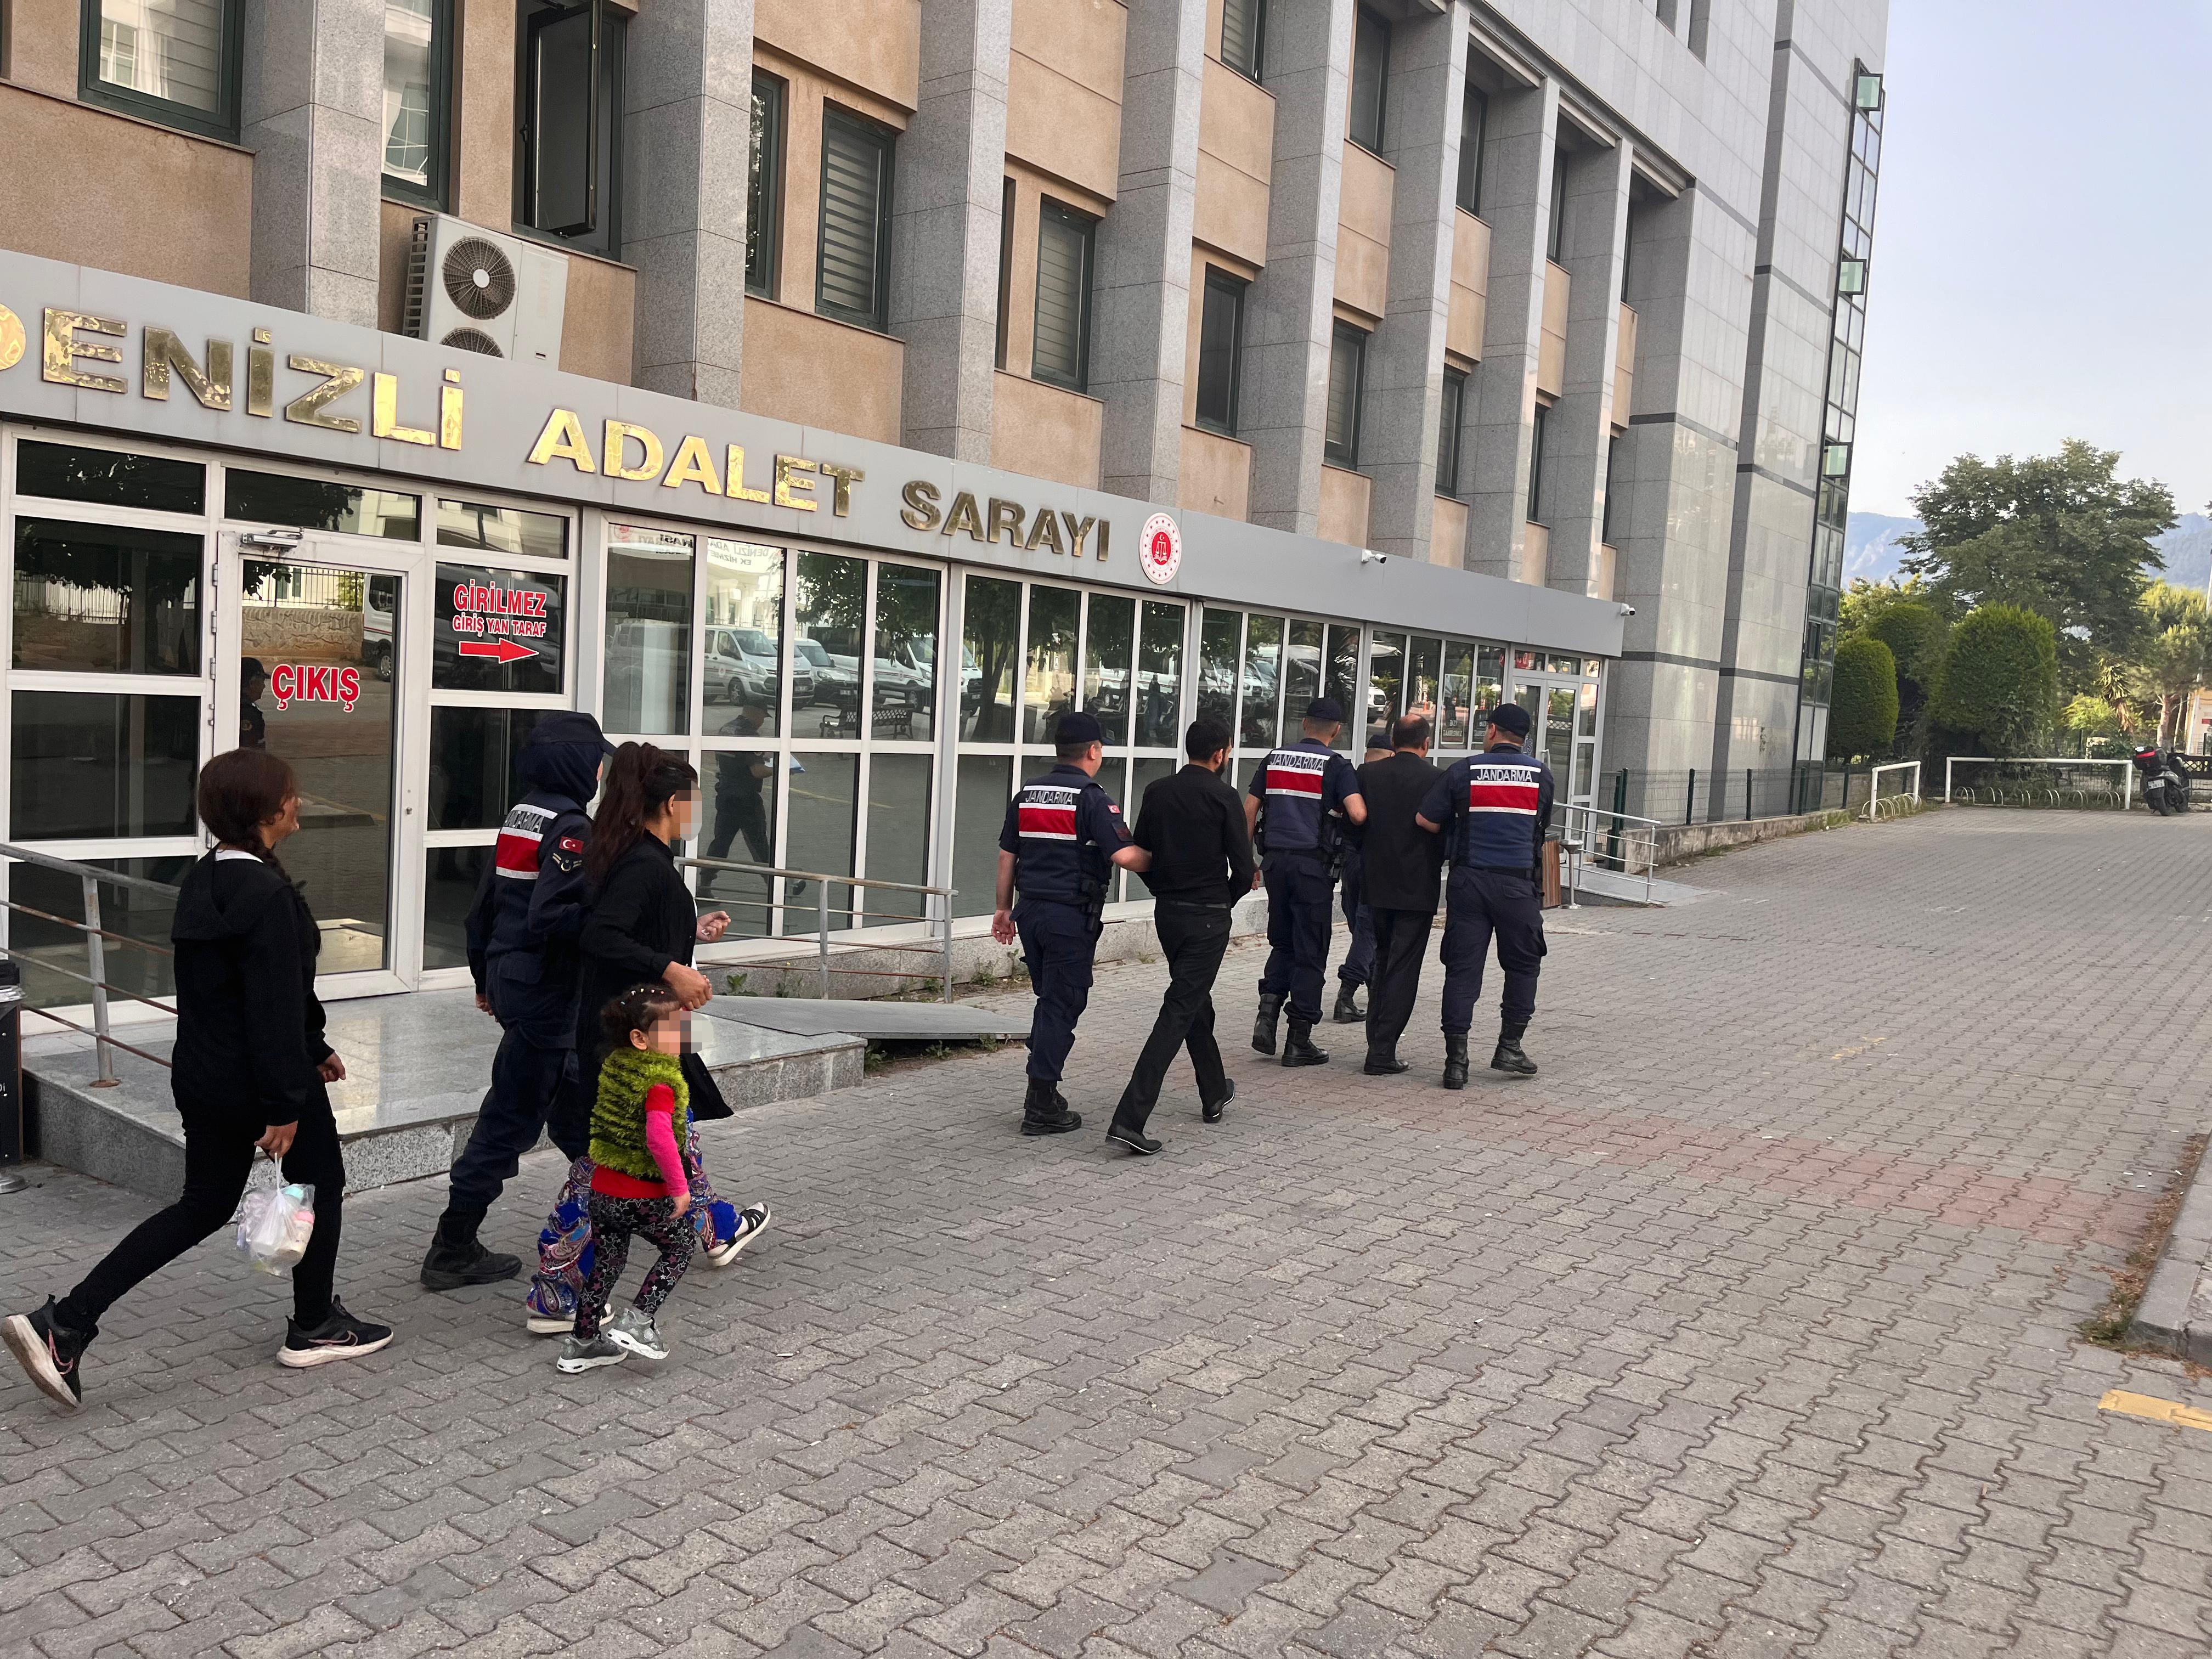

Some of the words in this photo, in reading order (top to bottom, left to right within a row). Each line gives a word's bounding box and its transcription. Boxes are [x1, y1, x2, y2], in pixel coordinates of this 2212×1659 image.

[527, 408, 865, 517] ADALET
[900, 479, 1111, 561] SARAYI
[454, 578, 547, 618] GİRİLMEZ
[453, 612, 484, 637] GİRİŞ
[486, 617, 510, 635] YAN
[512, 619, 547, 637] TARAF
[271, 664, 361, 713] ÇIKIŞ
[1269, 754, 1324, 771] JANDARMA
[1476, 769, 1533, 782] JANDARMA
[1025, 790, 1073, 805] JANDARMA
[504, 810, 545, 833] NDARMA
